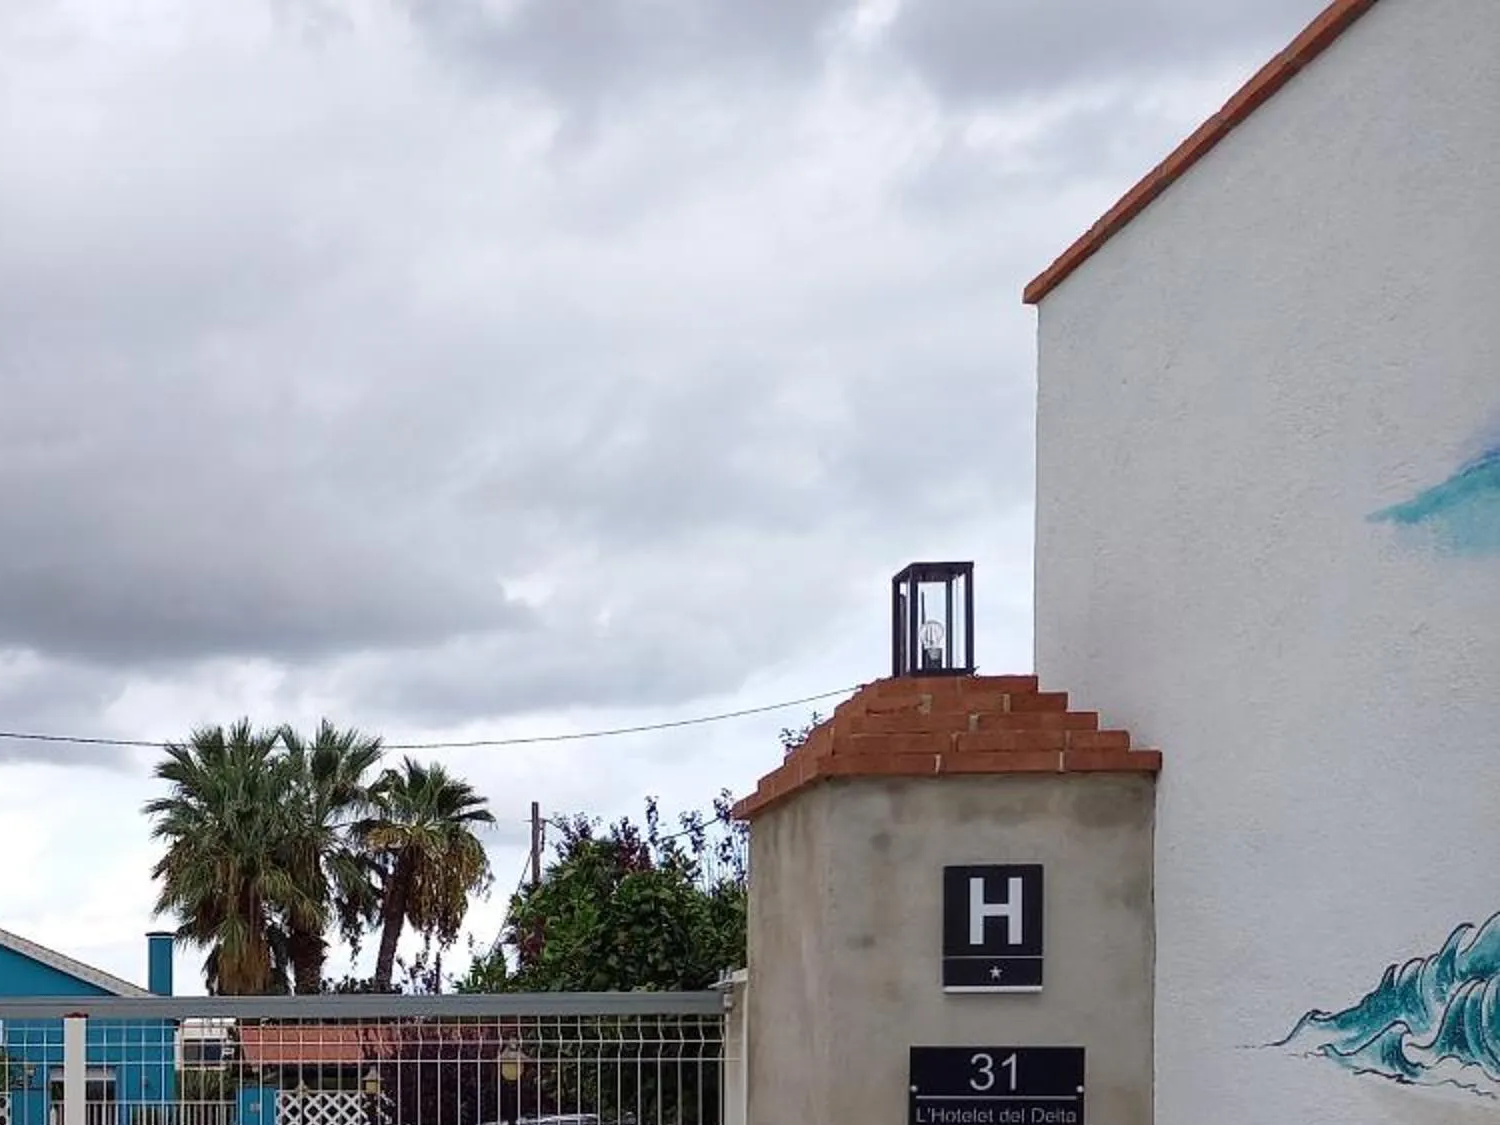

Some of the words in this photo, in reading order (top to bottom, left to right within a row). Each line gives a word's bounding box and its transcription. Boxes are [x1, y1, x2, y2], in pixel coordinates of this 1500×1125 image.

[969, 877, 1023, 945] H
[969, 1053, 1017, 1091] 31
[915, 1107, 994, 1123] L'Hotelet
[999, 1107, 1025, 1123] del
[1031, 1107, 1077, 1123] Delta
